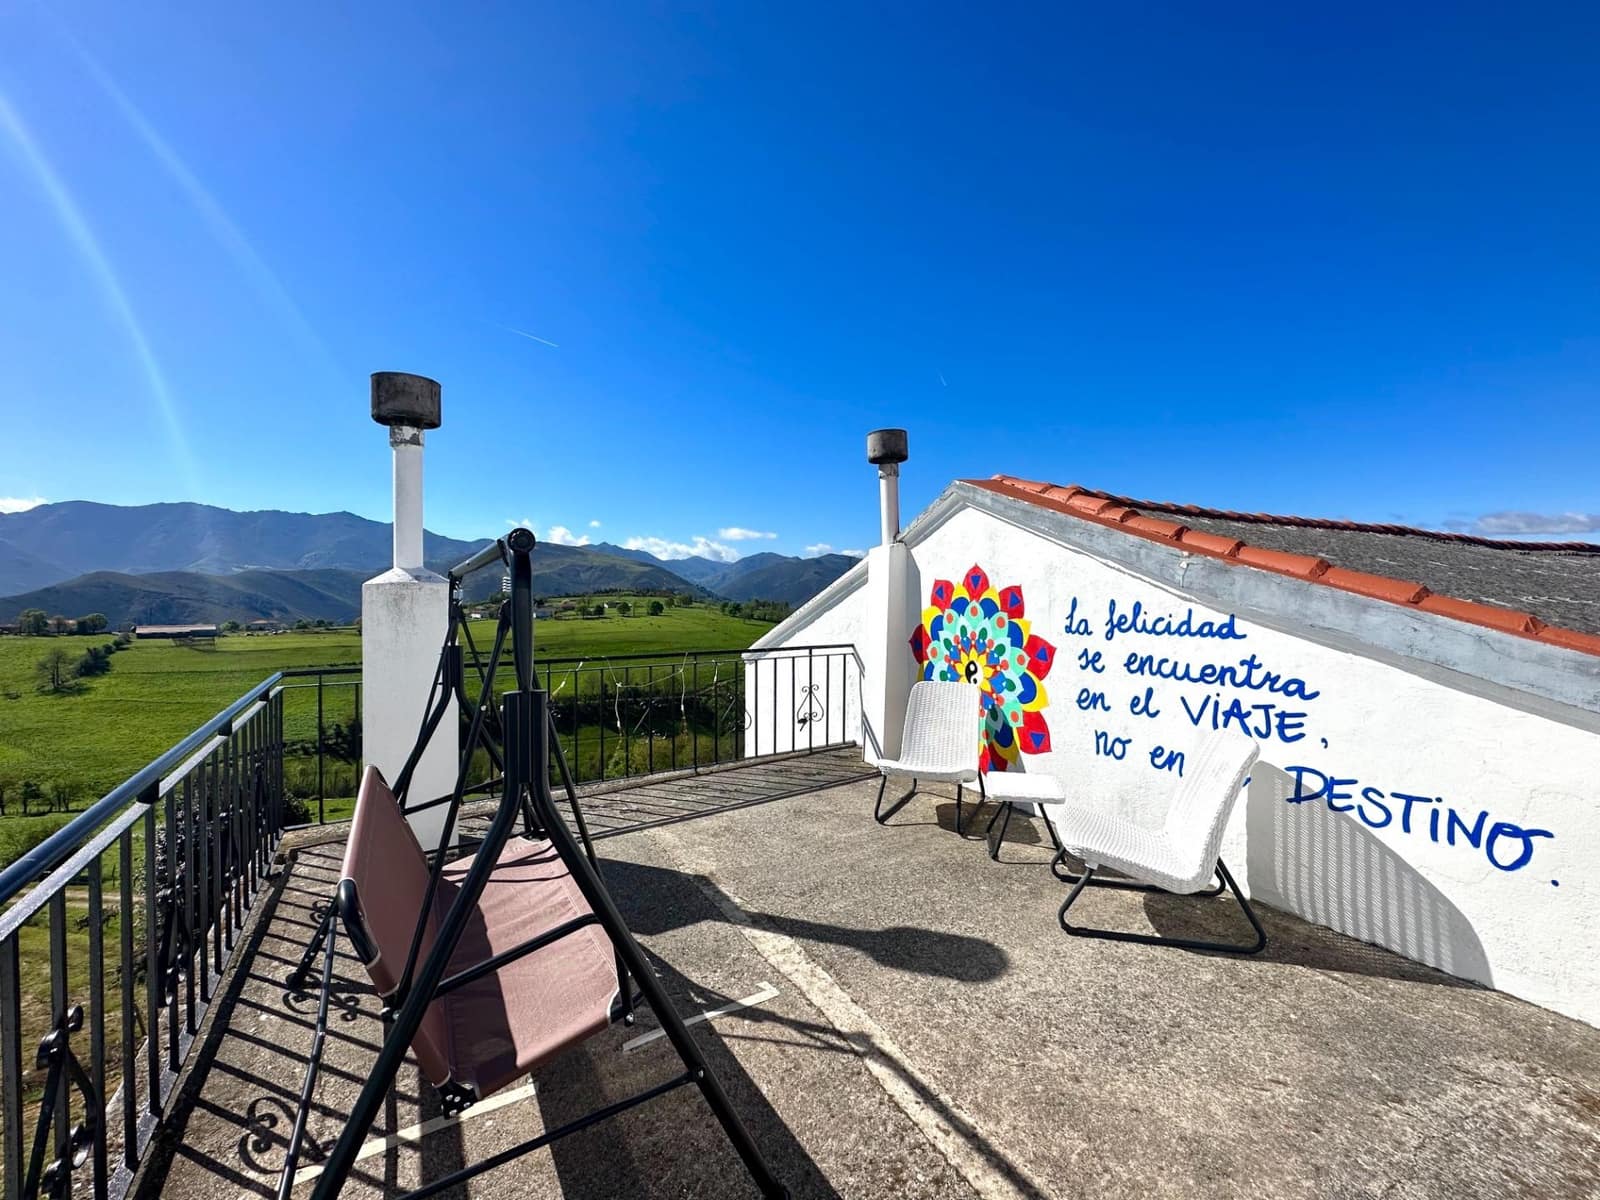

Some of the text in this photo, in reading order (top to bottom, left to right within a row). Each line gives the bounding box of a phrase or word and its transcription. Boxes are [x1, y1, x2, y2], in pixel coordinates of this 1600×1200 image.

[1064, 596, 1248, 642] La felicidad
[1077, 647, 1321, 701] se encuentra
[1076, 687, 1112, 712] en
[1129, 686, 1161, 719] el
[1094, 729, 1132, 761] no
[1149, 744, 1186, 777] en
